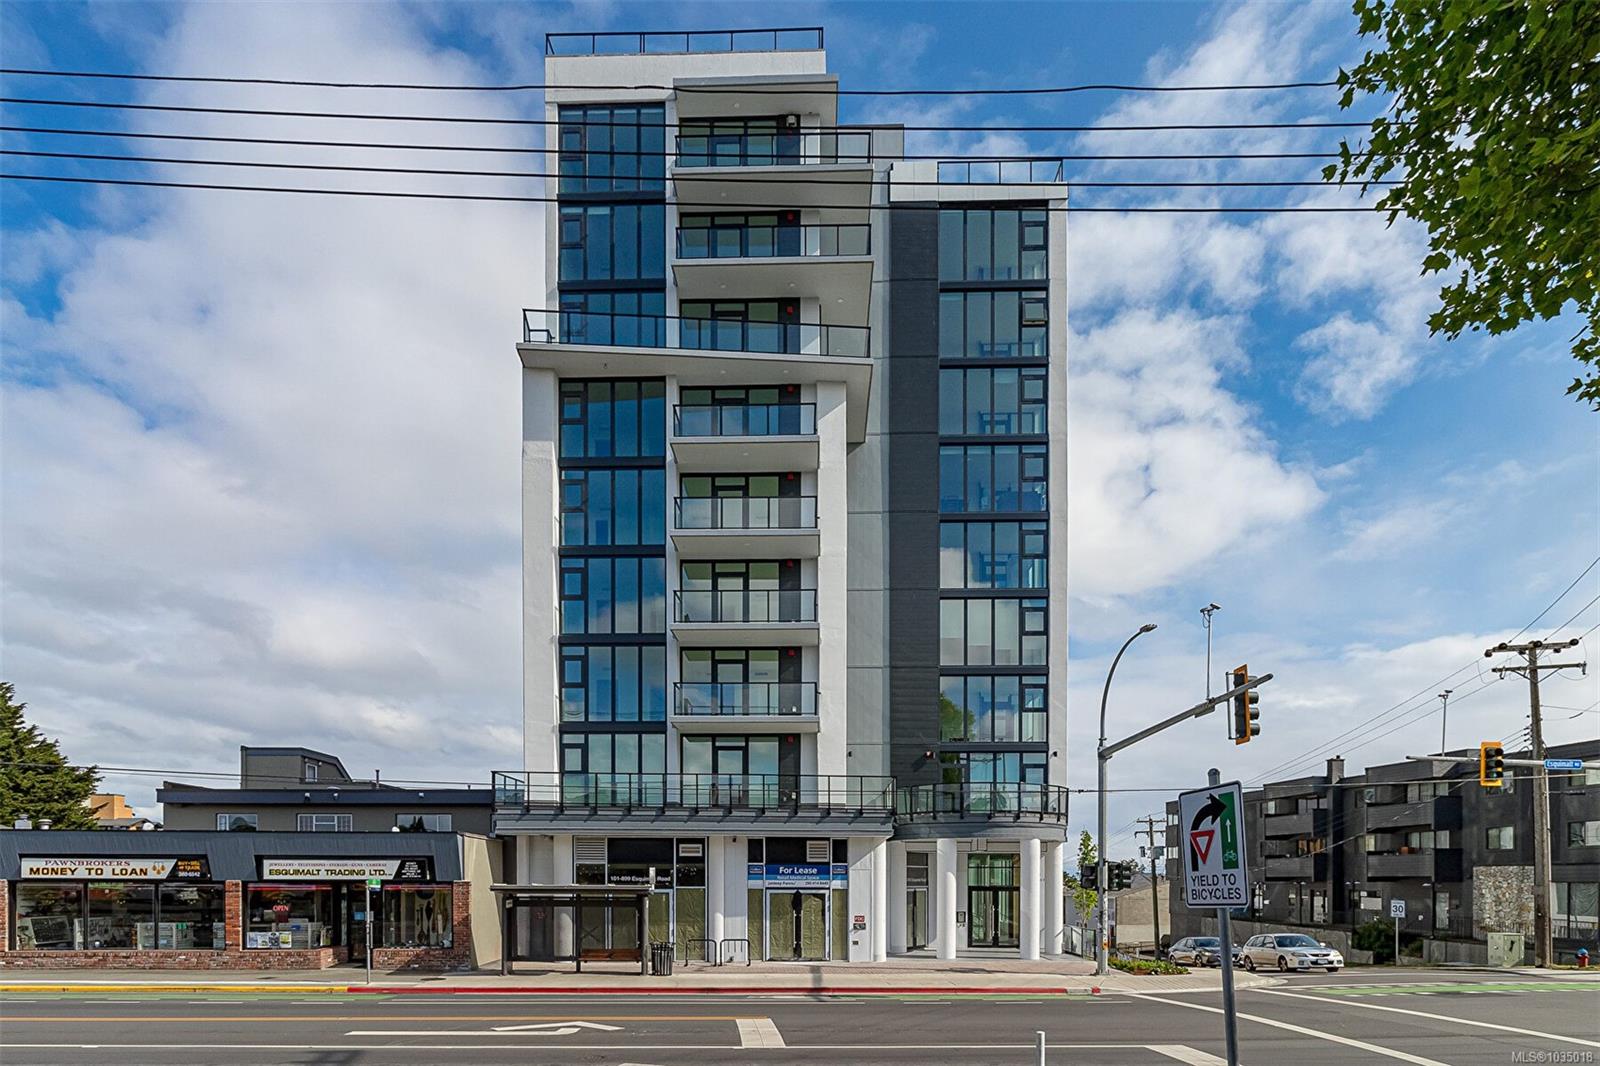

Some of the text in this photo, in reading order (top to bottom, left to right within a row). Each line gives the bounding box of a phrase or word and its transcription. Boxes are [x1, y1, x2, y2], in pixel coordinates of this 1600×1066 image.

[44, 859, 131, 867] PAWNBROKERS
[29, 867, 148, 876] MONEY TO LOAN
[779, 866, 818, 874] For Lease
[1191, 873, 1237, 887] YIELD TO
[1191, 887, 1242, 900] BICYCLES
[1392, 905, 1404, 913] 30
